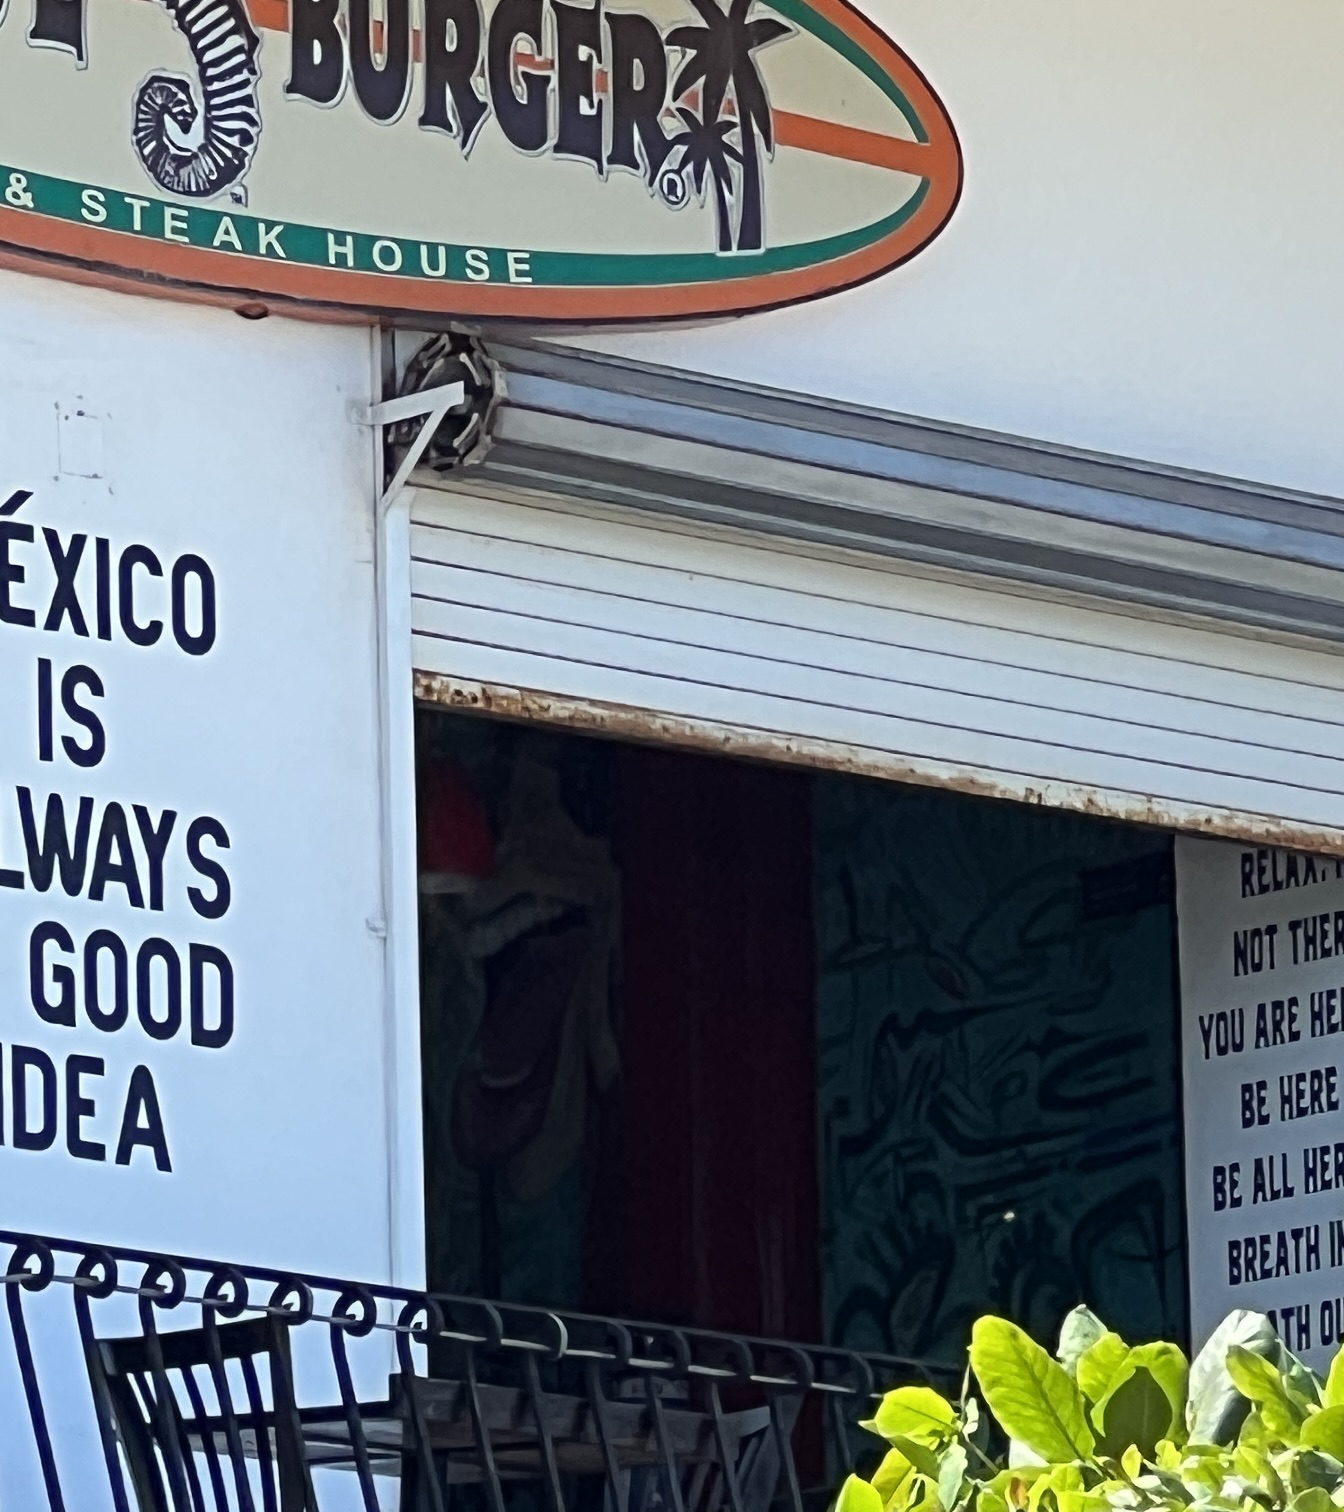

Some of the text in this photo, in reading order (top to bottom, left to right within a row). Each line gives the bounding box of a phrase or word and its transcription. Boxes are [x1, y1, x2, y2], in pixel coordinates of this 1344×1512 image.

[286, 0, 668, 198] BURGER
[5, 172, 34, 208] &
[81, 188, 288, 259] STEAK
[328, 234, 534, 283] HOUSE
[37, 657, 106, 768] IS
[1233, 924, 1278, 977] NOT
[28, 920, 234, 1049] GOOD
[1198, 1007, 1245, 1060] YOU
[1254, 996, 1301, 1050] ARE
[1240, 1066, 1340, 1129] BE HERE
[1212, 1162, 1243, 1212] BE
[1252, 1152, 1295, 1205] ALL
[1227, 1224, 1321, 1286] BREATH
